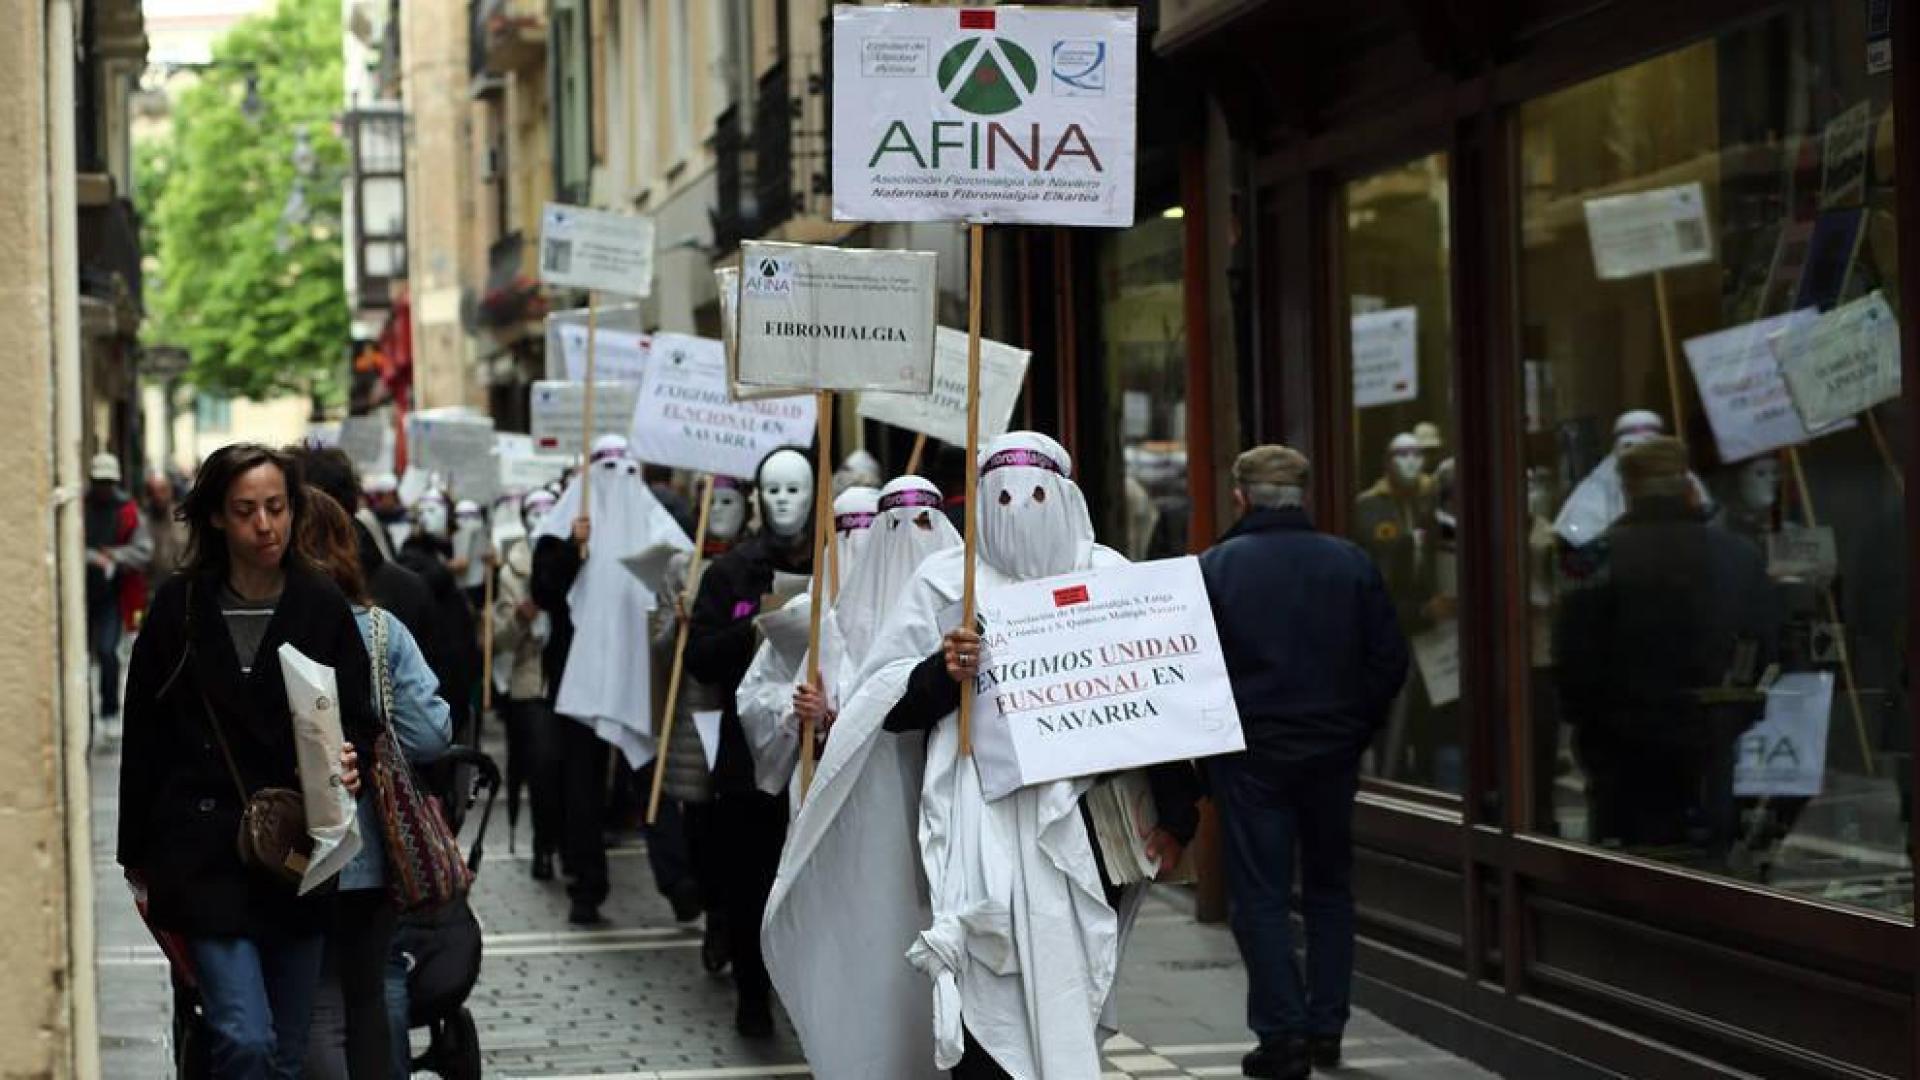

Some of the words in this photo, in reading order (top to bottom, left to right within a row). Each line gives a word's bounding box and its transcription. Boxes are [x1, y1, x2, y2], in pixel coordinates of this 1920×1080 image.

[868, 119, 1104, 172] AFINA
[871, 174, 941, 186] Asociación
[944, 175, 1024, 188] Fibromialgia
[1028, 176, 1045, 187] de
[871, 187, 949, 199] Nafarroako
[952, 188, 1040, 201] Fibromialgia
[1043, 190, 1100, 202] Elkartea
[746, 276, 791, 293] AFINA
[765, 320, 908, 343] FIBROMIALGIA
[663, 403, 756, 432] FUNCIONAL
[762, 420, 784, 434] EN
[682, 425, 757, 450] NAVARRA
[976, 649, 1093, 696] EXIGIMOS
[1100, 634, 1198, 665] UNIDAD
[996, 671, 1148, 716] FUNCIONAL
[1152, 664, 1186, 685] EN
[1037, 700, 1160, 735] NAVARRA
